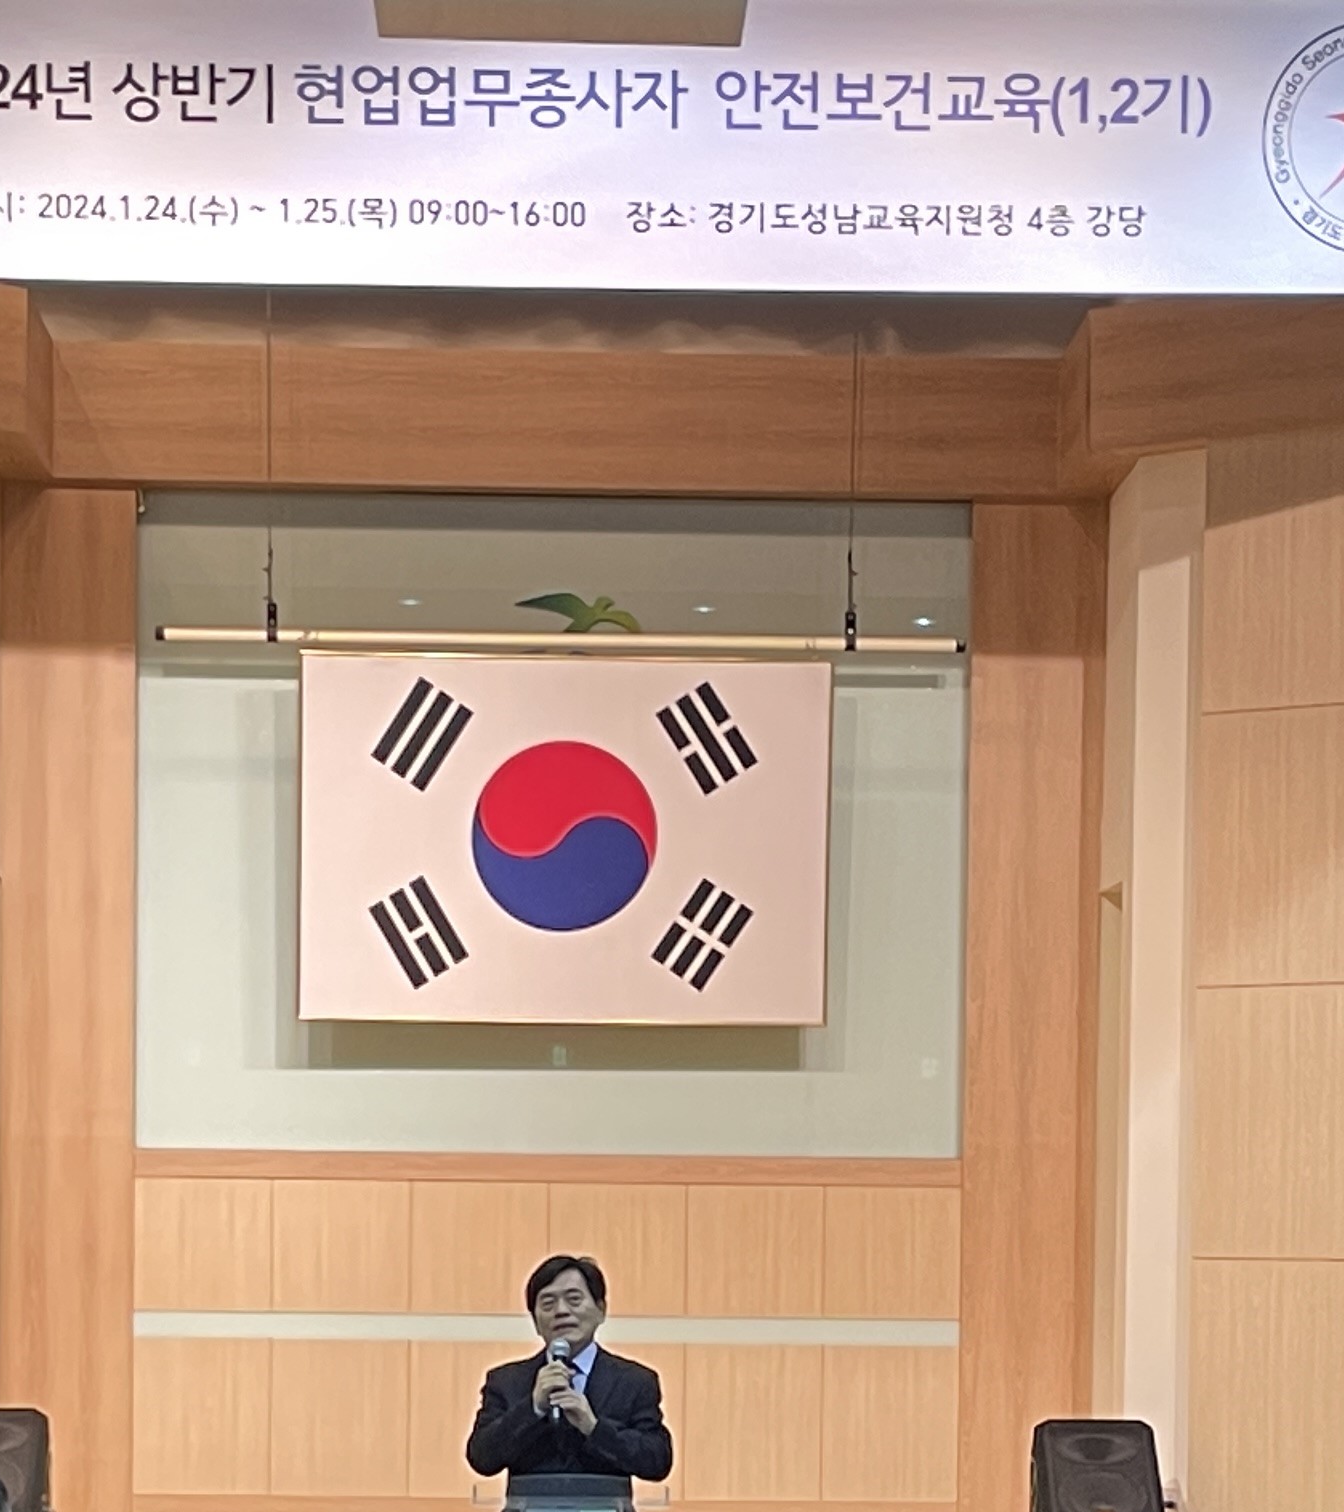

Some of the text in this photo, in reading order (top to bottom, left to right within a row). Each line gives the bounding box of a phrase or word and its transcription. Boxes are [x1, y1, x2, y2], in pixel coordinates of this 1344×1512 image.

[112, 61, 274, 124] 상반기
[294, 64, 690, 130] 현업업무종사자
[715, 69, 1212, 138] 안전보건교육(1,2기)
[1271, 72, 1304, 184] Gyeonggido
[37, 194, 239, 227] 2024.1.24.(수)
[279, 197, 398, 230] 1.25.(목)
[408, 199, 587, 228] 09:00~16:00
[626, 201, 696, 233] 장소:
[708, 202, 1014, 237] 경기도성남교육지원청
[1026, 205, 1075, 237] 4층
[1087, 205, 1147, 237] 강당
